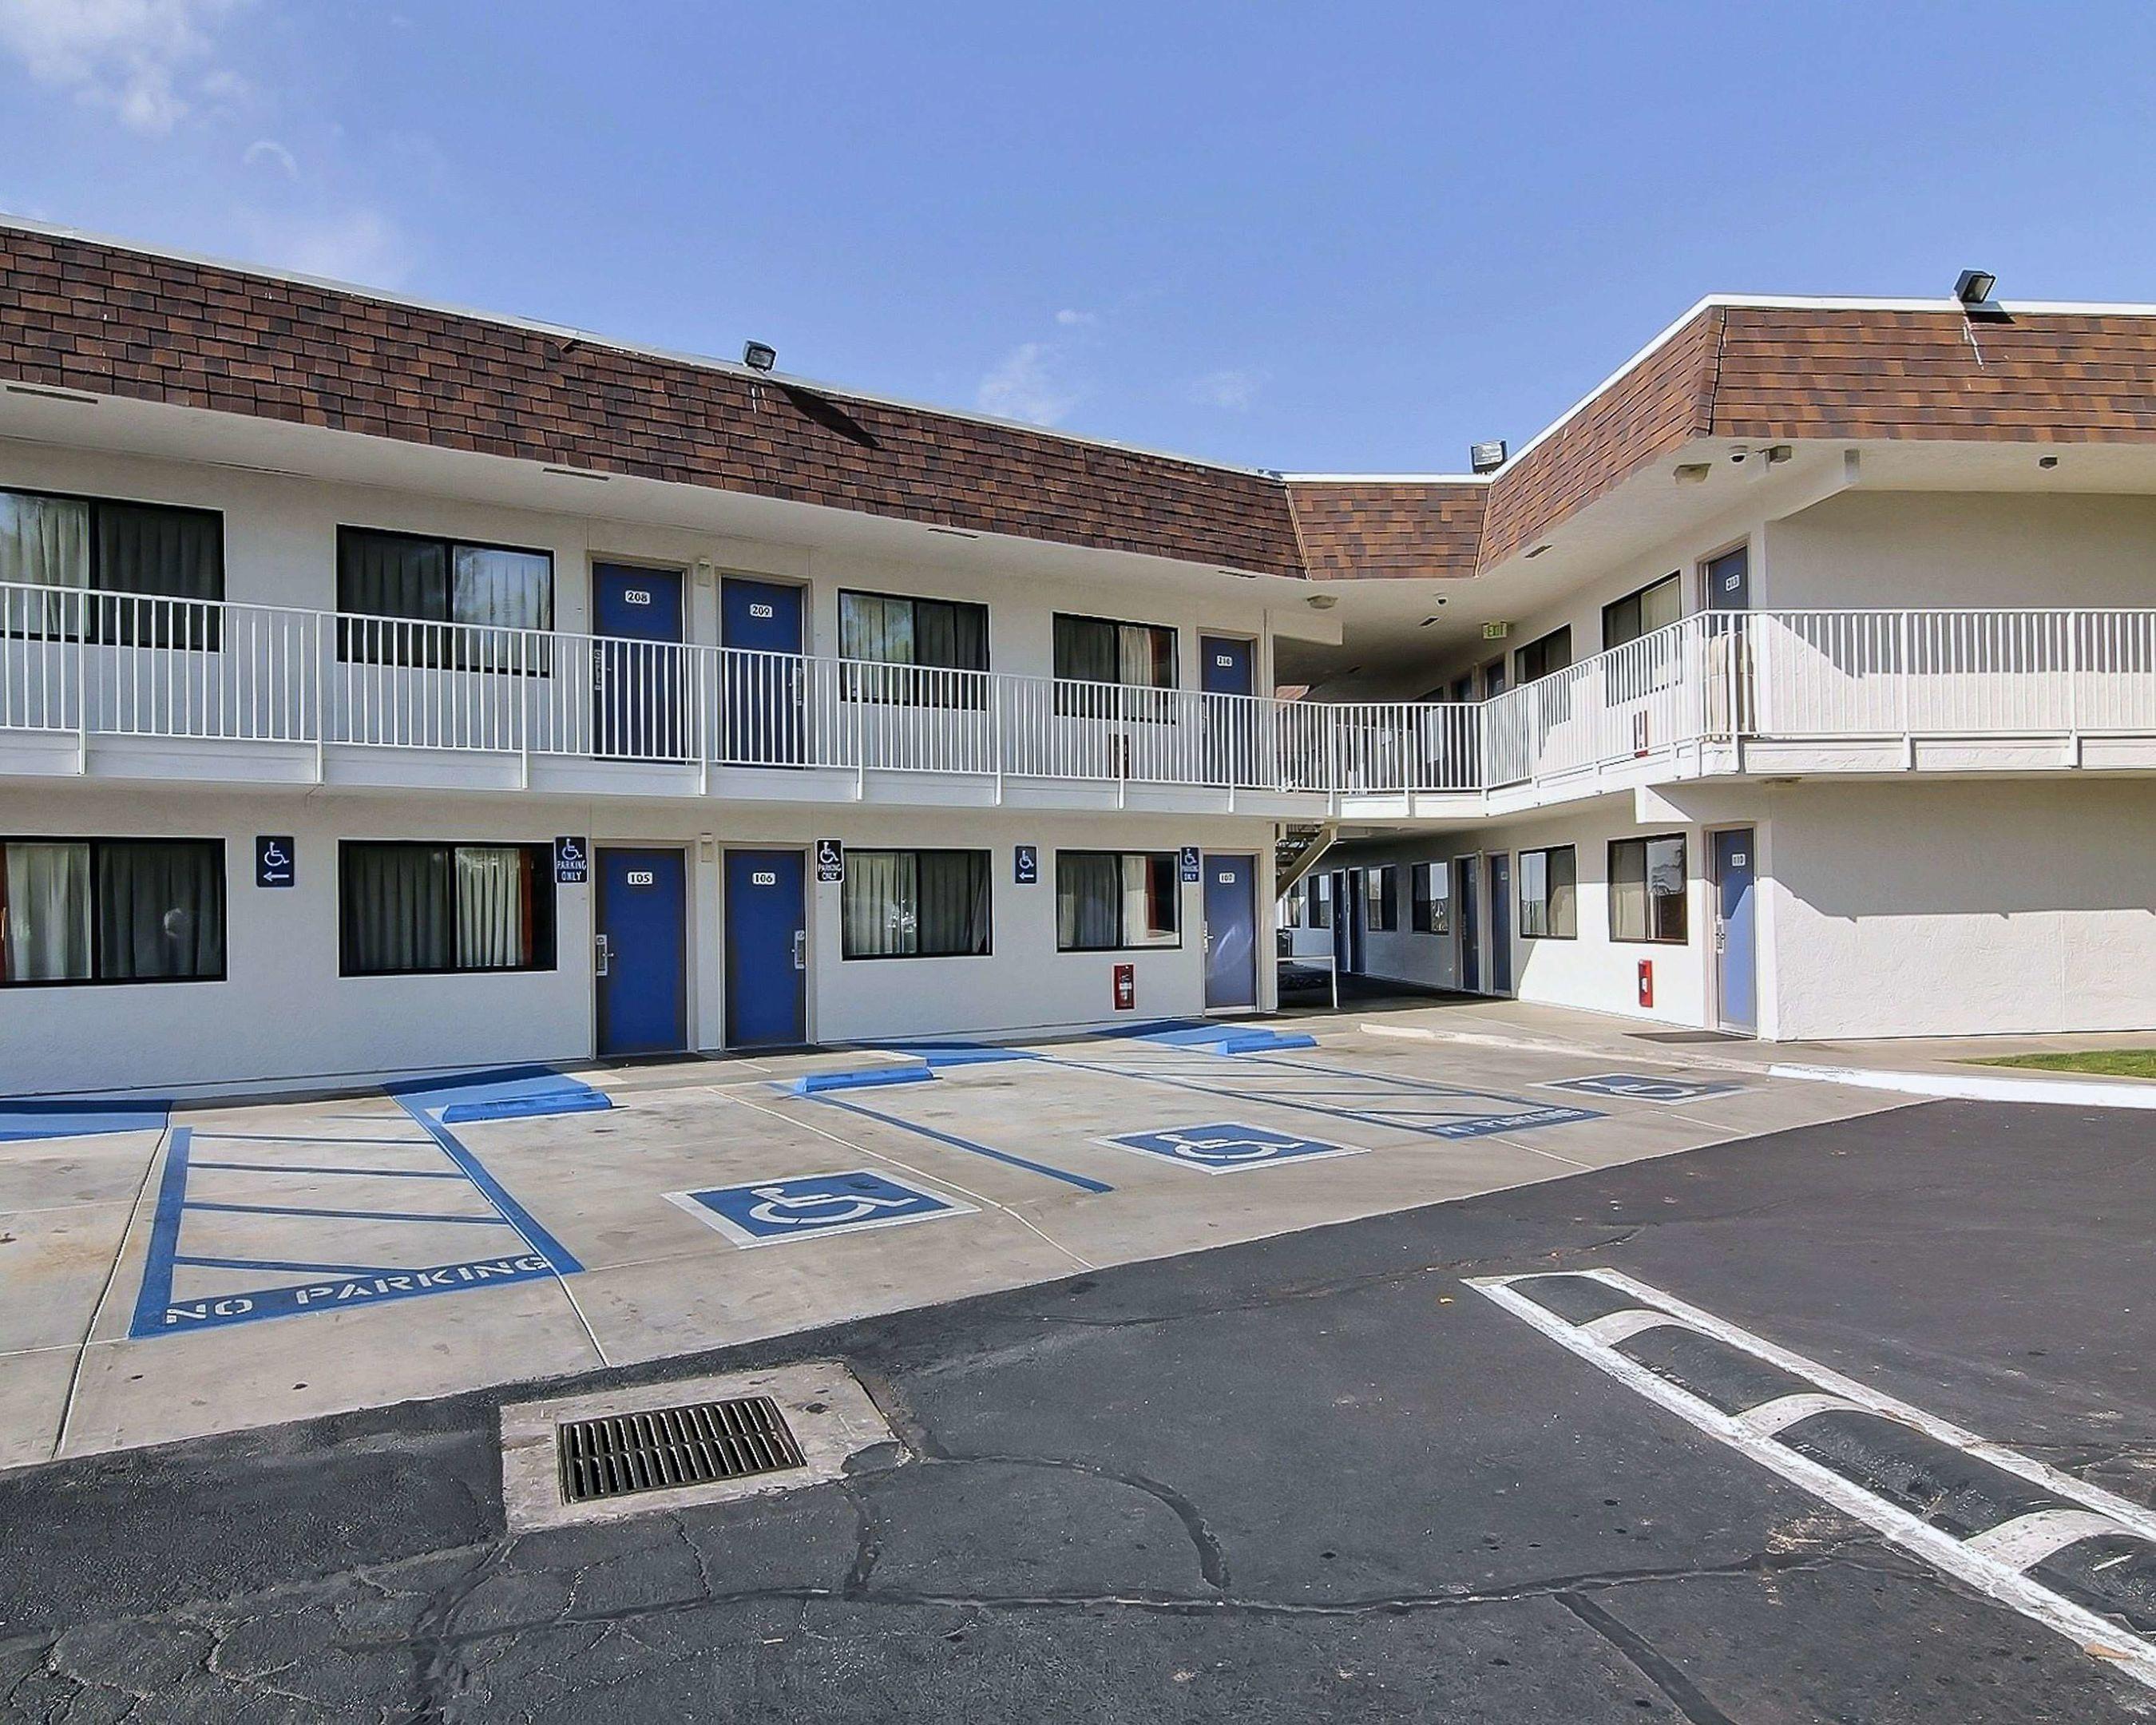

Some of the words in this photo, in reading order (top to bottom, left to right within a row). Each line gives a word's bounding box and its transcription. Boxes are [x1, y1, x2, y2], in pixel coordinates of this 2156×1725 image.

[628, 592, 648, 603] 208
[752, 605, 770, 616] 209
[557, 860, 587, 871] PARKING
[818, 862, 841, 873] PARKING
[561, 871, 582, 882] ONLY
[630, 874, 651, 884] 105
[755, 873, 773, 884] 106
[822, 872, 838, 881] ONLY
[166, 1299, 253, 1324] NO
[295, 1256, 549, 1306] PARKING
